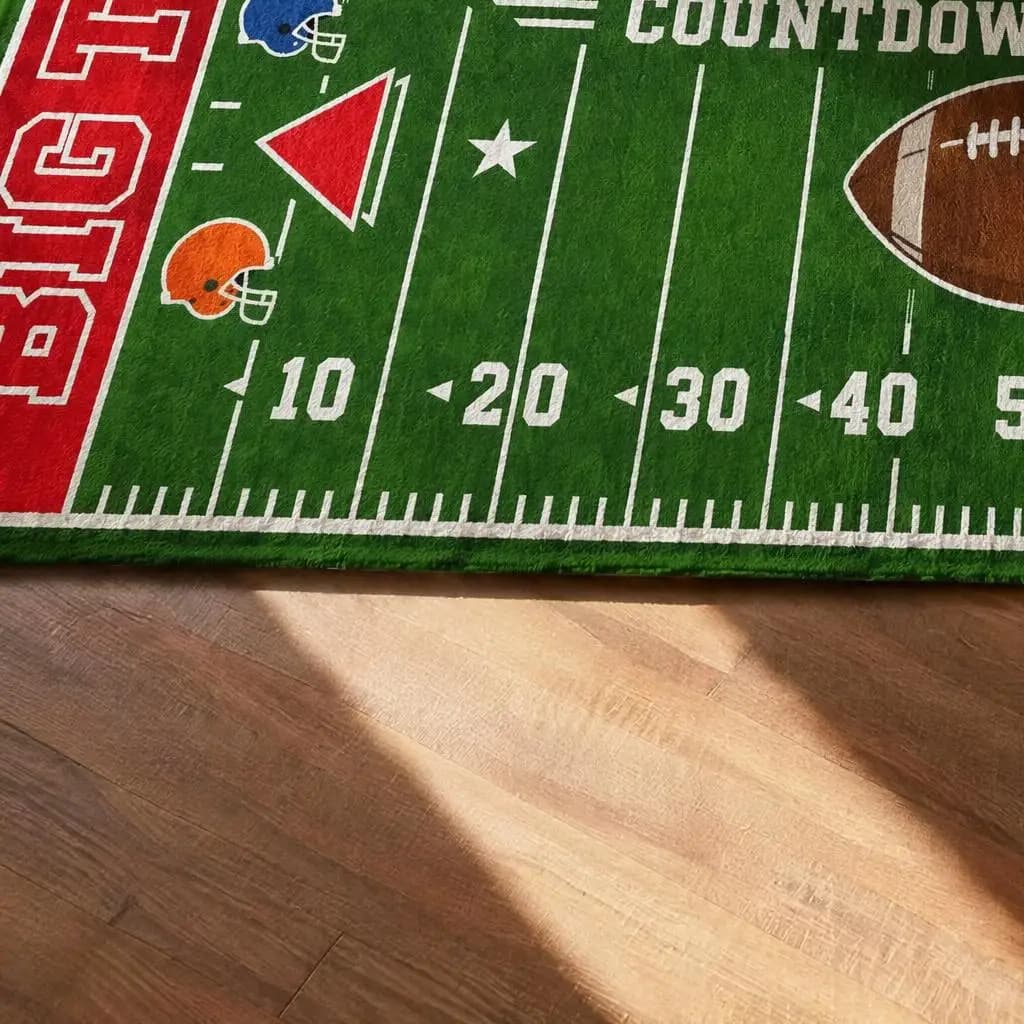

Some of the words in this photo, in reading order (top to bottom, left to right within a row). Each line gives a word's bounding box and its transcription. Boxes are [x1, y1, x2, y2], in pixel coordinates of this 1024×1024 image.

[0, 112, 152, 406] BIG
[269, 356, 356, 422] 10
[461, 361, 569, 427] 20
[660, 366, 750, 432] 30
[830, 371, 918, 437] 40
